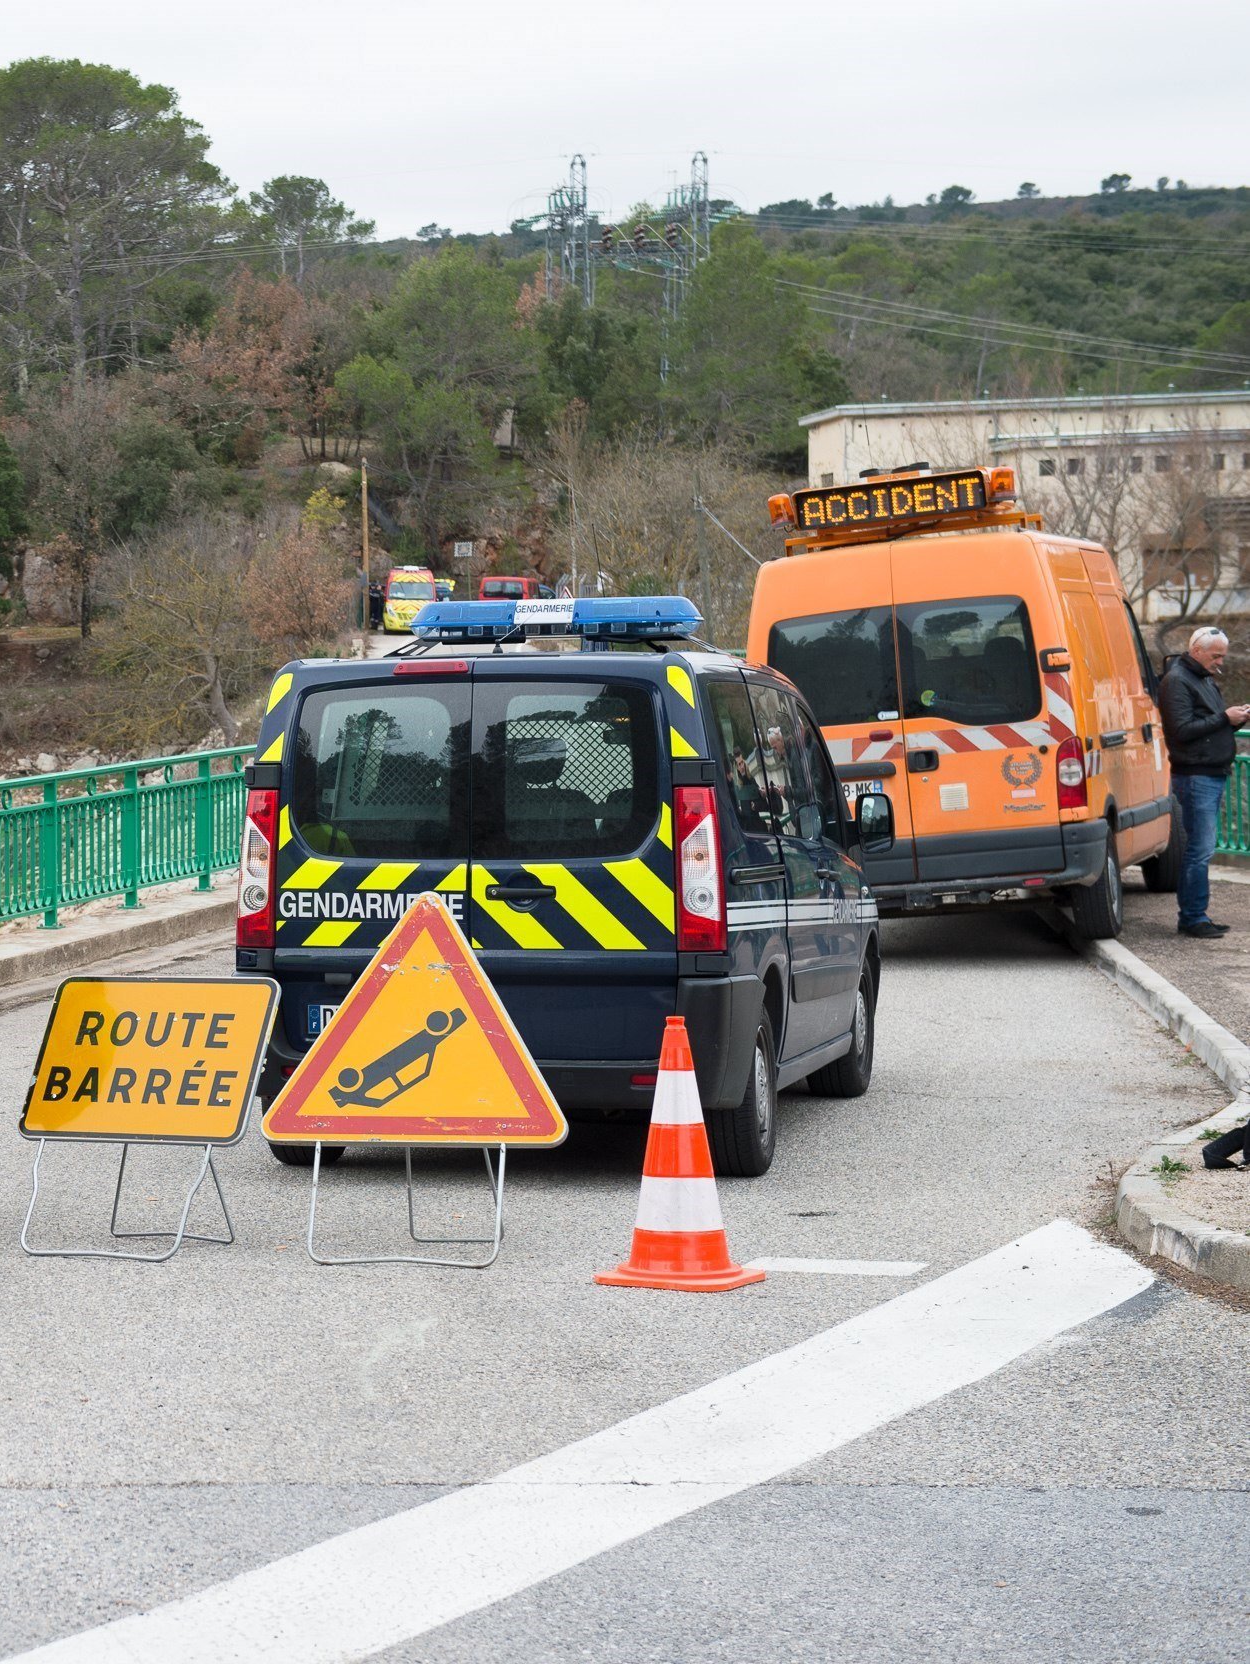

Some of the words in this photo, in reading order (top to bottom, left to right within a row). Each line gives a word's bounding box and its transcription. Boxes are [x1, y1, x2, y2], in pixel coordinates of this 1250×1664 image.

[803, 477, 980, 526] ACCIDENT
[516, 604, 574, 613] GENDARMERIE
[279, 891, 464, 920] GENDARME
[75, 1011, 235, 1048] ROUTE
[43, 1060, 238, 1106] BARRÉE
